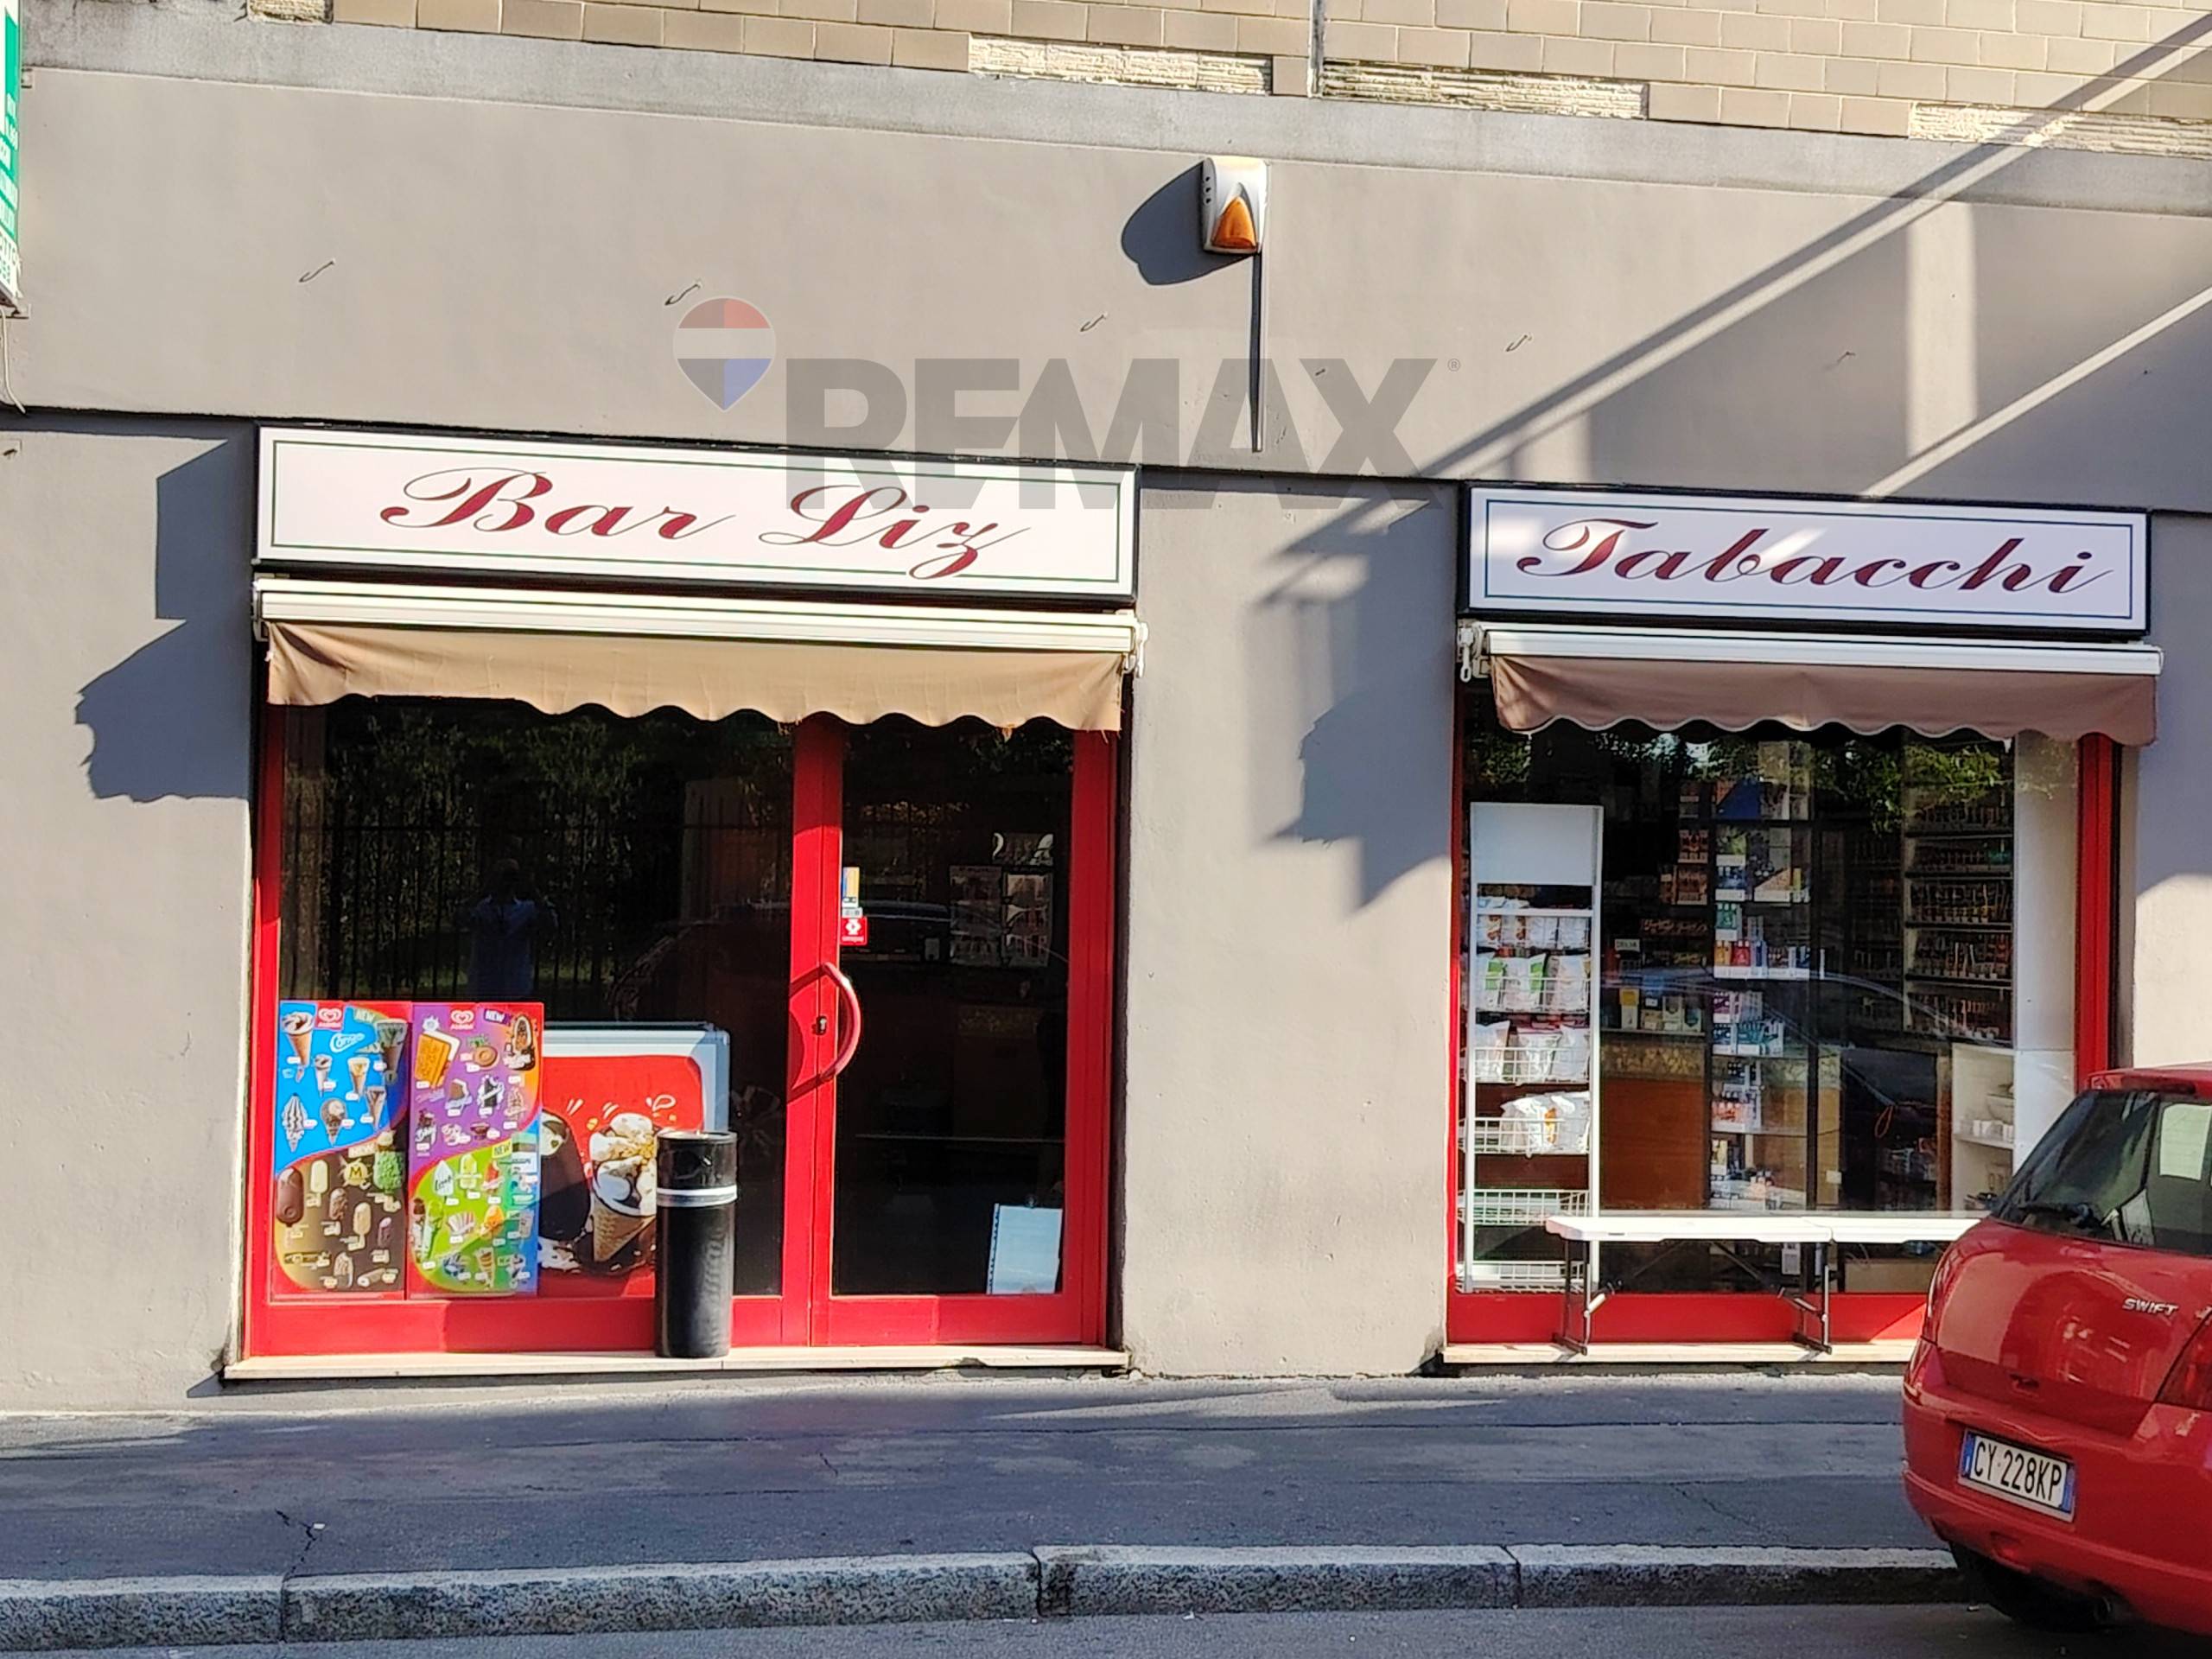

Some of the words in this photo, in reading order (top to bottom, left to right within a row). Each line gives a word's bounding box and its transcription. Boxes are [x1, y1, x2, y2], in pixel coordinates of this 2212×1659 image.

[379, 467, 735, 539] Bar
[758, 484, 1032, 580] Liz
[1516, 518, 2114, 594] Tabacchi
[2122, 1298, 2179, 1316] SWIFT
